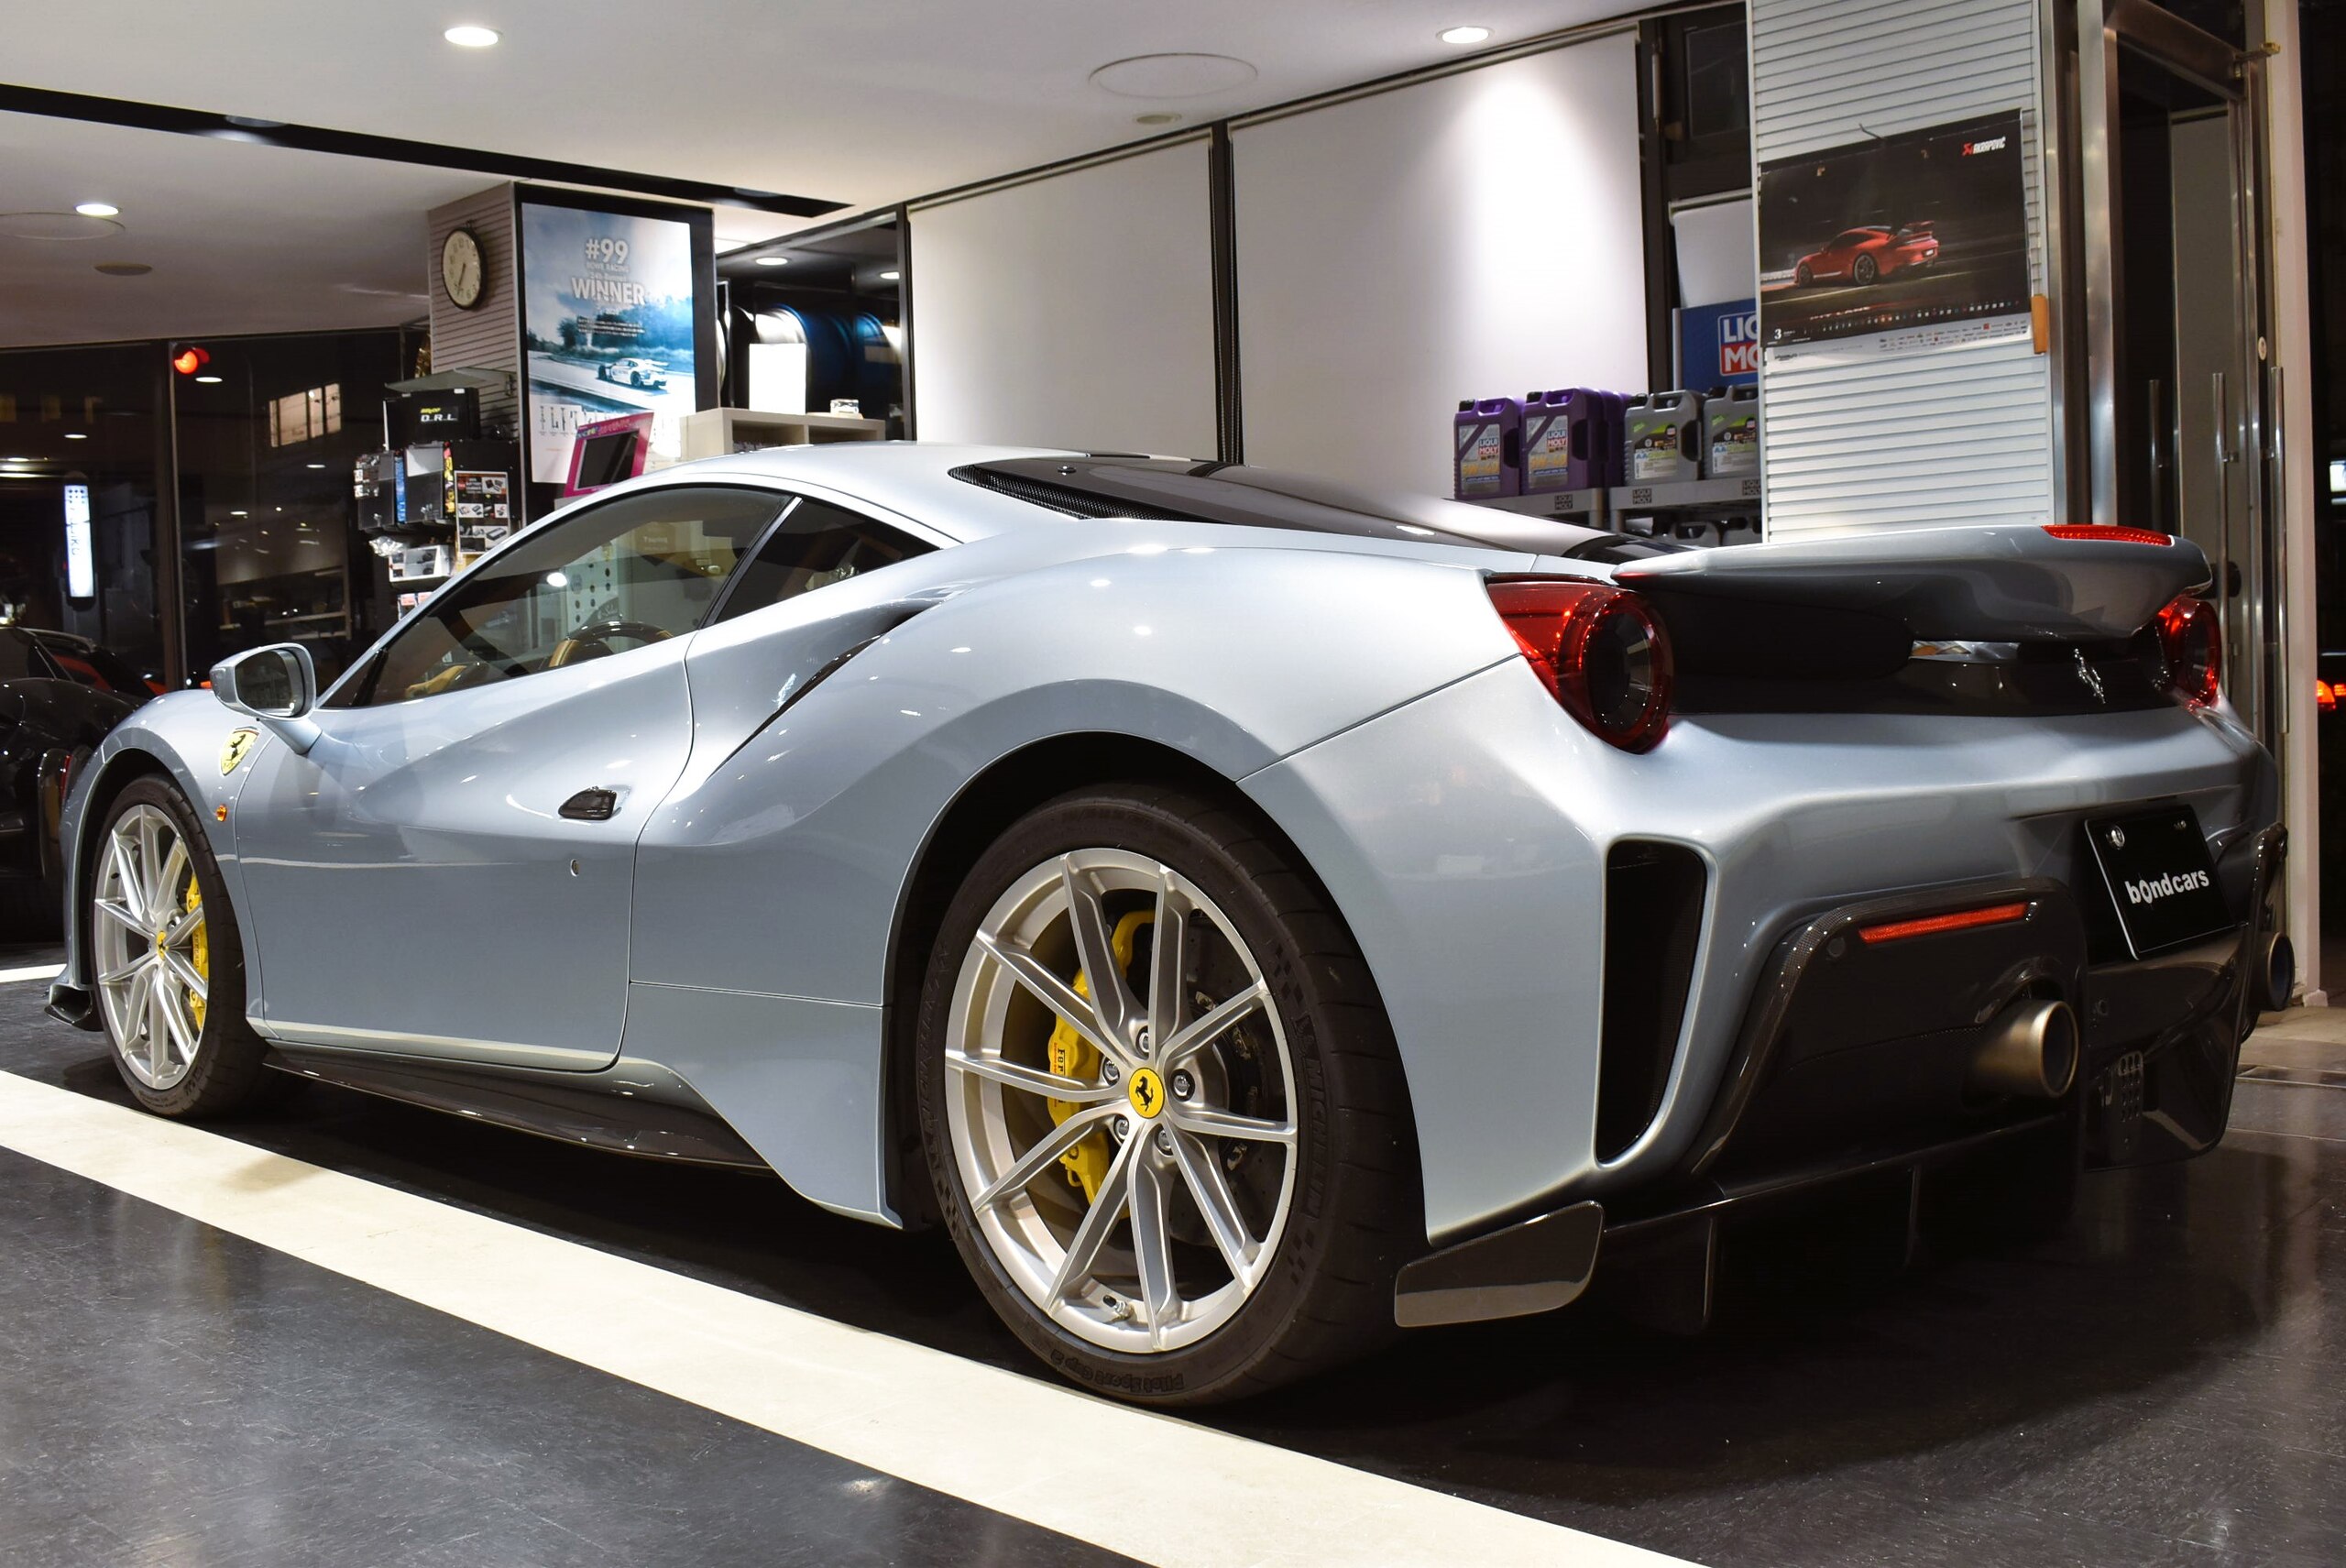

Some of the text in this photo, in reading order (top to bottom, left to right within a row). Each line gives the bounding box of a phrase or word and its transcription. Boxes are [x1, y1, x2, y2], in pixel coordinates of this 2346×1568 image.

[585, 237, 630, 265] #99
[571, 277, 646, 306] WINNER
[1774, 328, 1782, 340] 3
